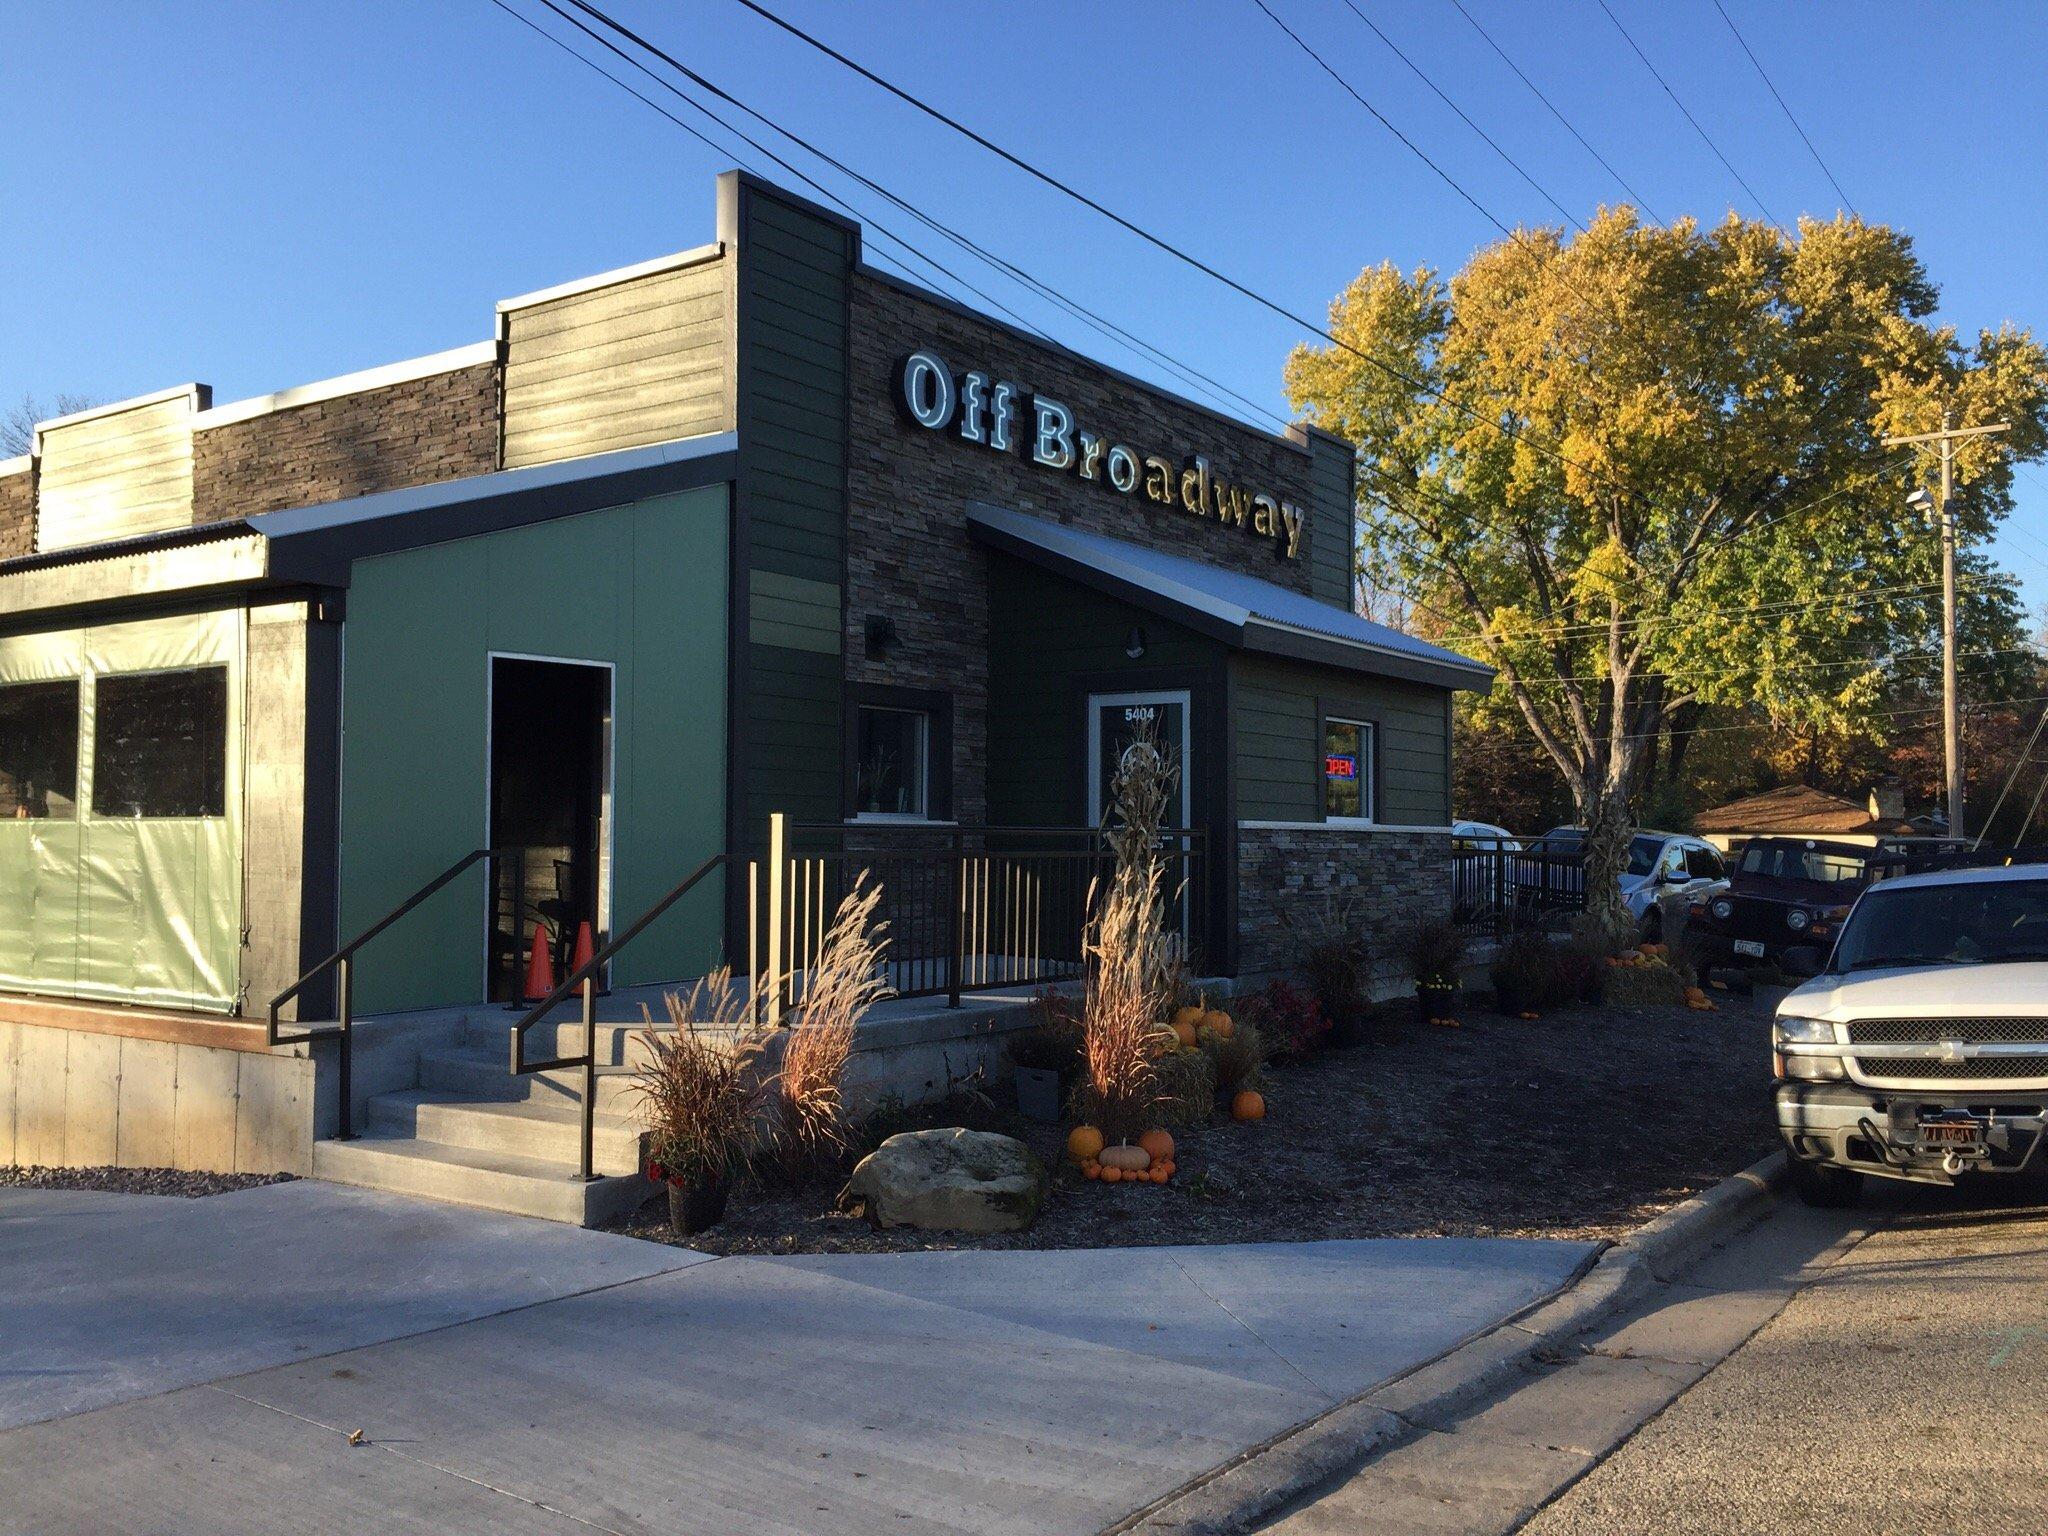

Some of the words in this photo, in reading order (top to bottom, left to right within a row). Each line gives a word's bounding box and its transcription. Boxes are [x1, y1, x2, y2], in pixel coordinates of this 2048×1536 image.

[904, 351, 1017, 453] Off
[1033, 394, 1306, 559] Broadway
[1125, 708, 1155, 721] 5404
